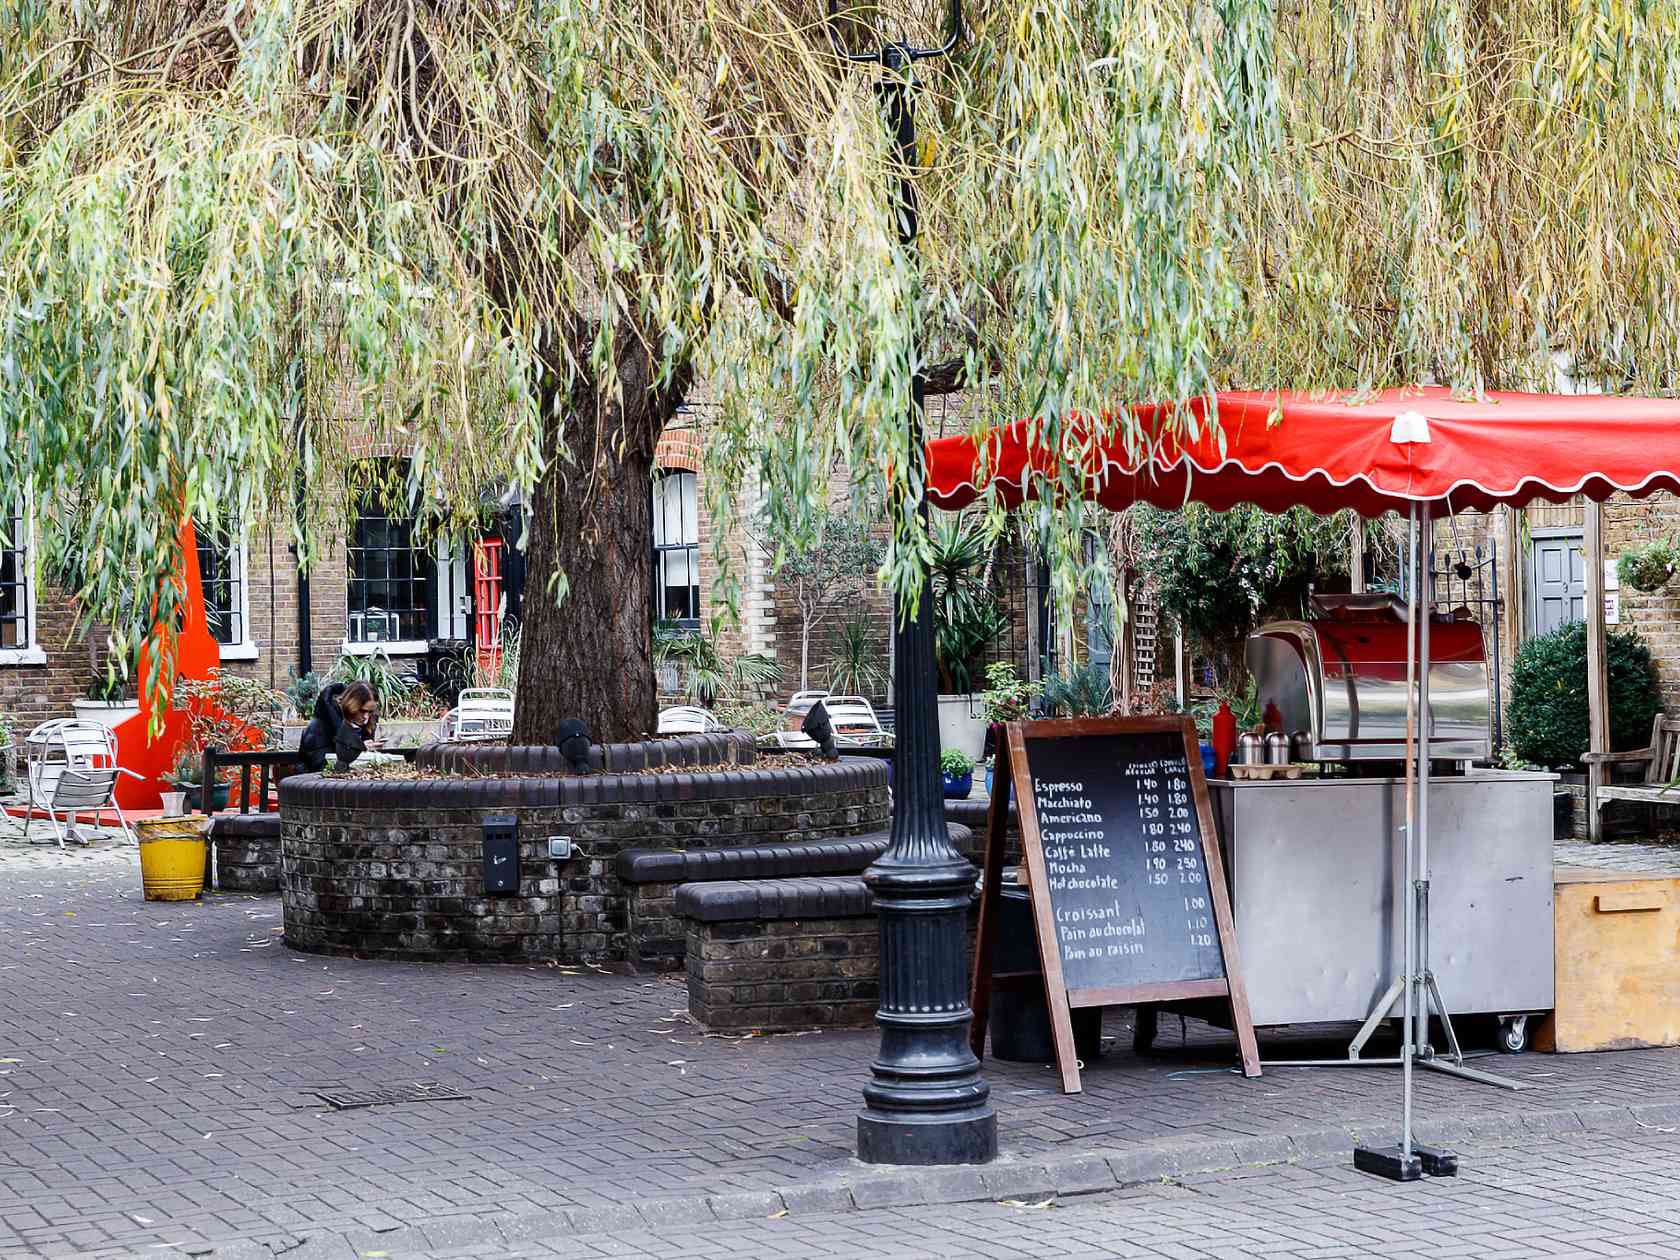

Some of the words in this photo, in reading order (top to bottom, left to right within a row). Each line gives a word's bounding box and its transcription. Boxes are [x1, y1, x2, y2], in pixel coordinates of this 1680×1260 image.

[1035, 778, 1083, 799] Espresso
[1037, 796, 1092, 809] Macchiato
[1138, 793, 1160, 806] 1.40
[1168, 792, 1188, 805] 1.80
[1040, 812, 1103, 824] Americano
[1168, 807, 1190, 819] 2.00
[1041, 828, 1105, 845] Cappuccino
[1080, 843, 1112, 859] Latte
[1048, 861, 1087, 875] Mocha
[1056, 899, 1121, 922] Croissant
[1060, 925, 1087, 942] Pain
[1064, 945, 1087, 961] Pain
[1088, 947, 1103, 959] au
[1107, 942, 1145, 957] raisin
[1190, 934, 1212, 947] 1.20
